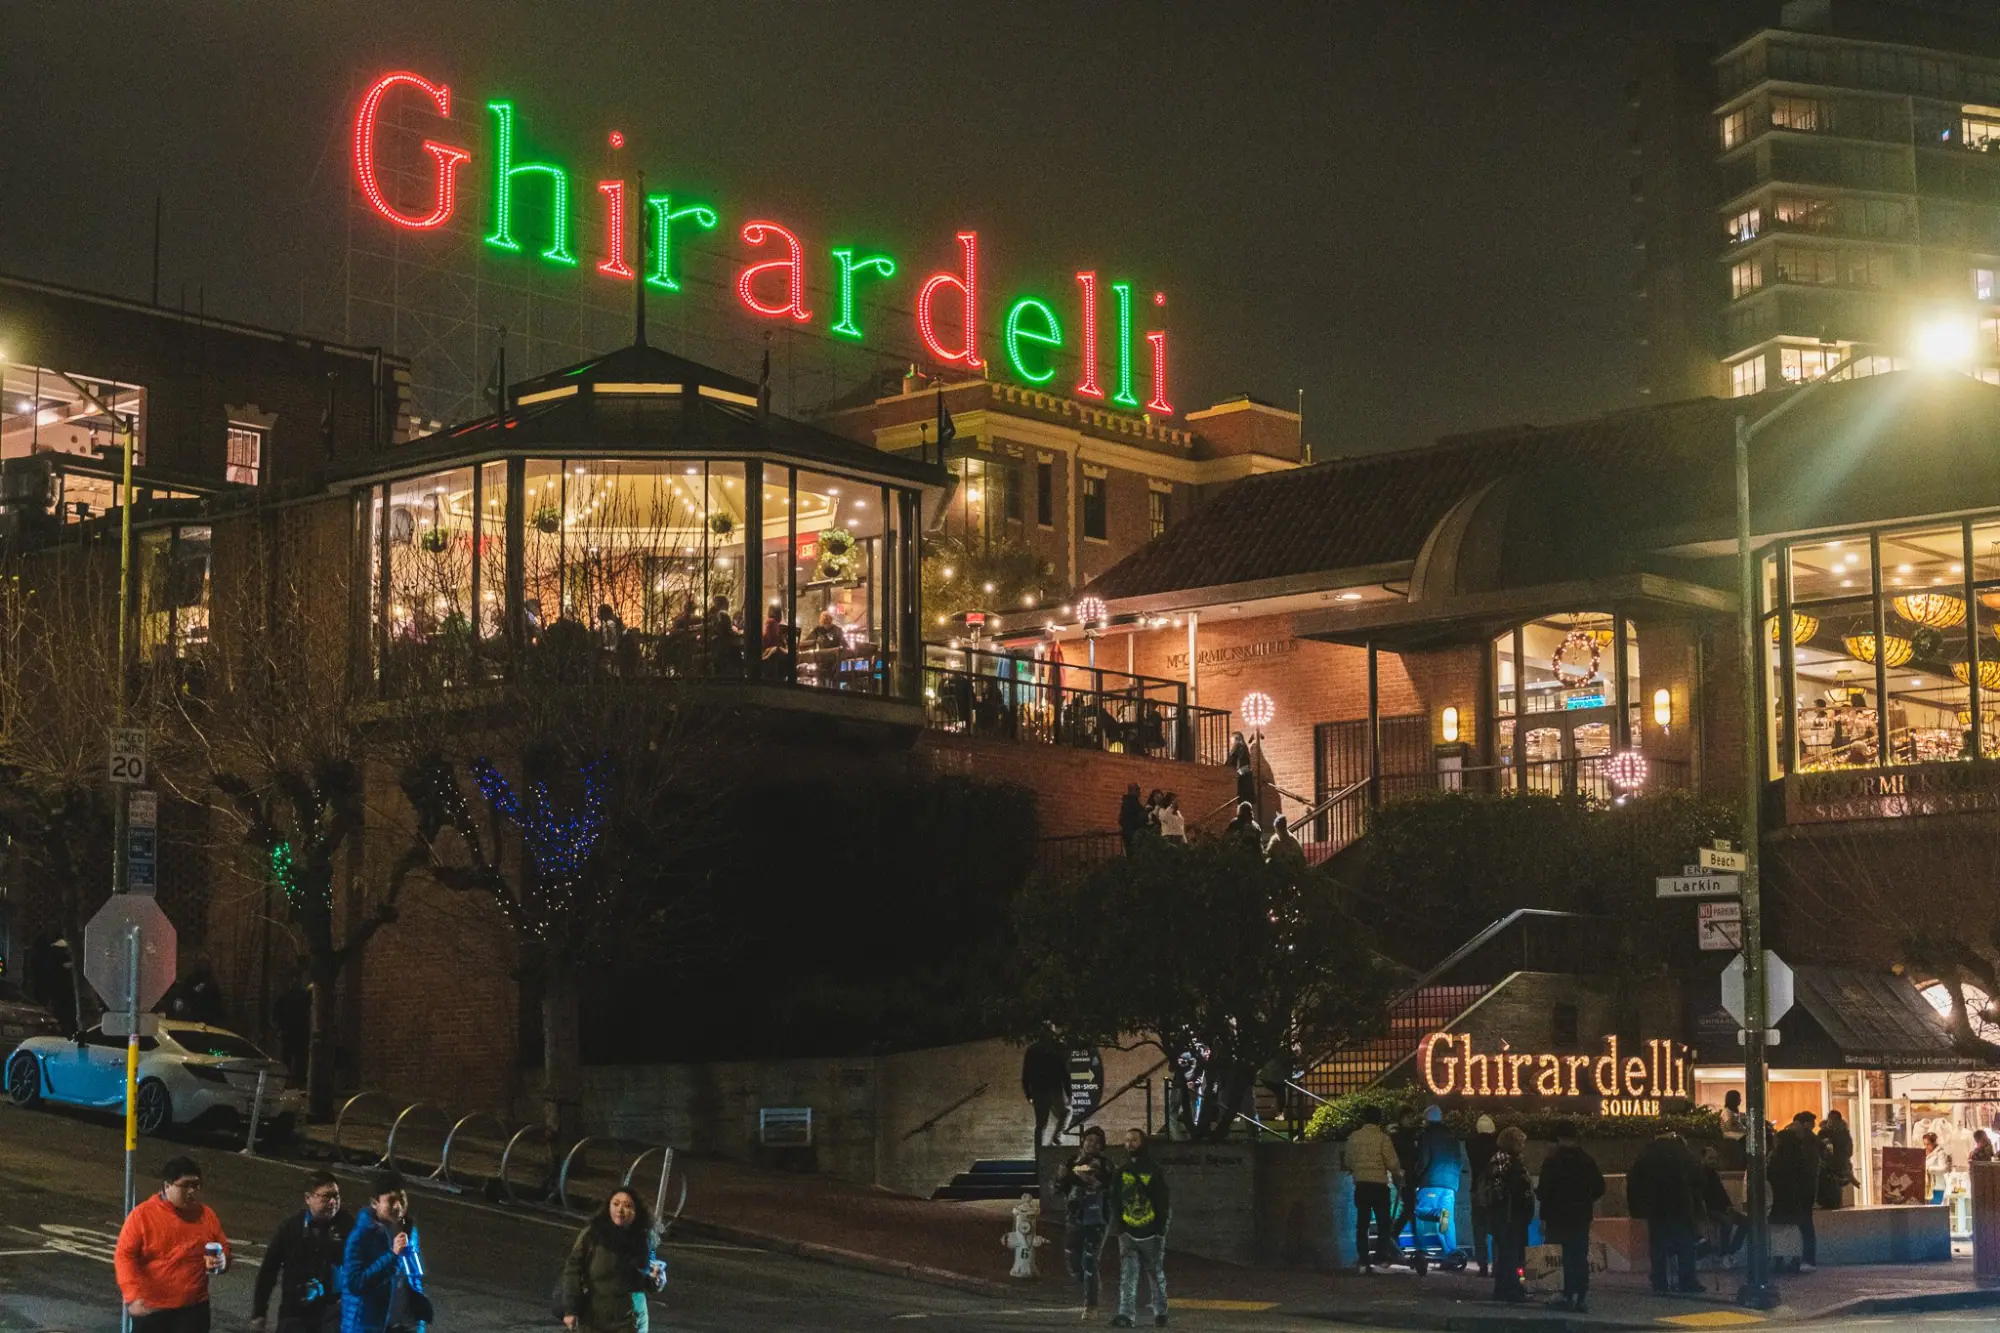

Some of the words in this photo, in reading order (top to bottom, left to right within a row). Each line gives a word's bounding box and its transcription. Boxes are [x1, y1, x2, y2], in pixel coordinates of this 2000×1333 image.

[354, 70, 1174, 414] Ghirardelli
[112, 756, 142, 778] 20
[1711, 853, 1736, 867] Beach
[1673, 880, 1721, 892] Larkin
[1420, 1032, 1688, 1096] Ghirardelli
[1601, 1099, 1660, 1116] SQUARE
[1021, 1248, 1029, 1259] 6
